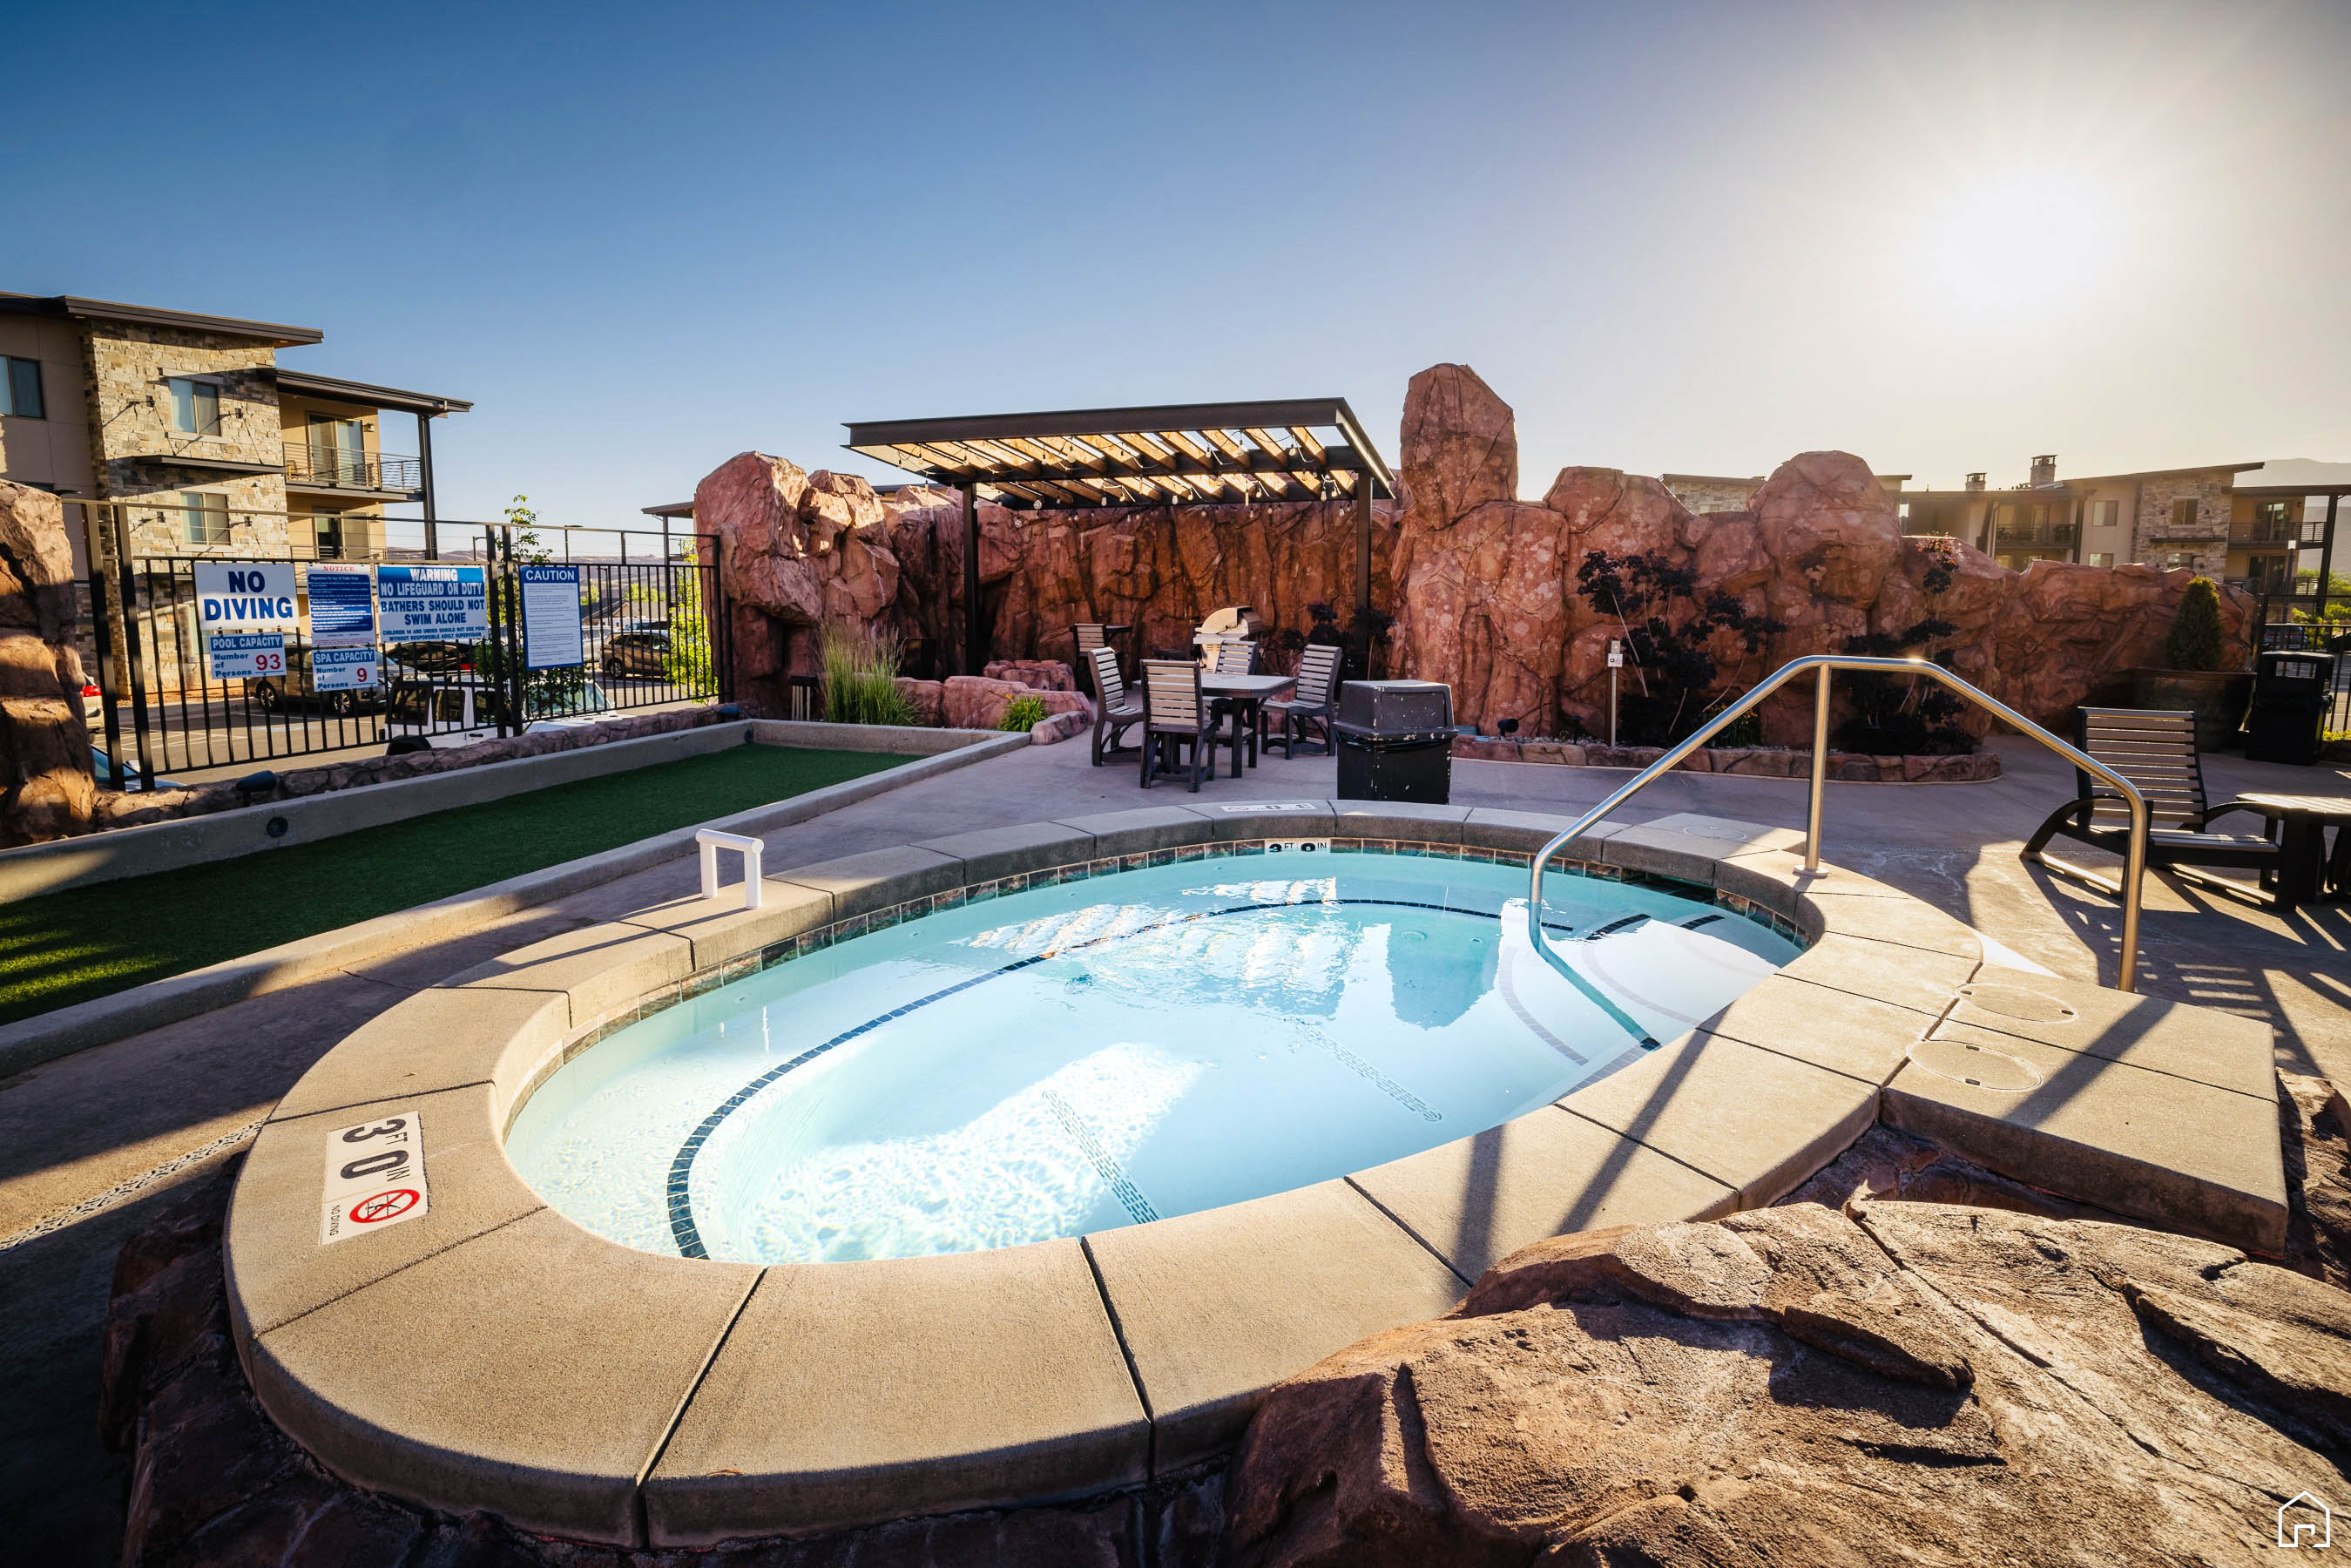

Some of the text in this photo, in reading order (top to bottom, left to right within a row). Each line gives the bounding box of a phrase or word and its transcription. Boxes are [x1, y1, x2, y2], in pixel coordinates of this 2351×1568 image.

[409, 569, 458, 581] WARNING
[525, 570, 575, 581] CAUTION
[228, 571, 265, 593] NO
[381, 582, 482, 596] NO LIFEGUARD ON DUTY
[204, 597, 293, 620] DIVING
[381, 599, 485, 612] BATHERS SHOULD NOT
[404, 612, 466, 625] SWIM ALONE
[213, 636, 280, 648] POOL CAPACITY
[255, 654, 281, 671] 93
[315, 651, 373, 663] SPA CAPACITY
[357, 667, 368, 682] 9
[1301, 843, 1315, 852] 0
[341, 1119, 410, 1182] 3 FT 0 IN
[329, 1205, 341, 1236] NO DIVING
